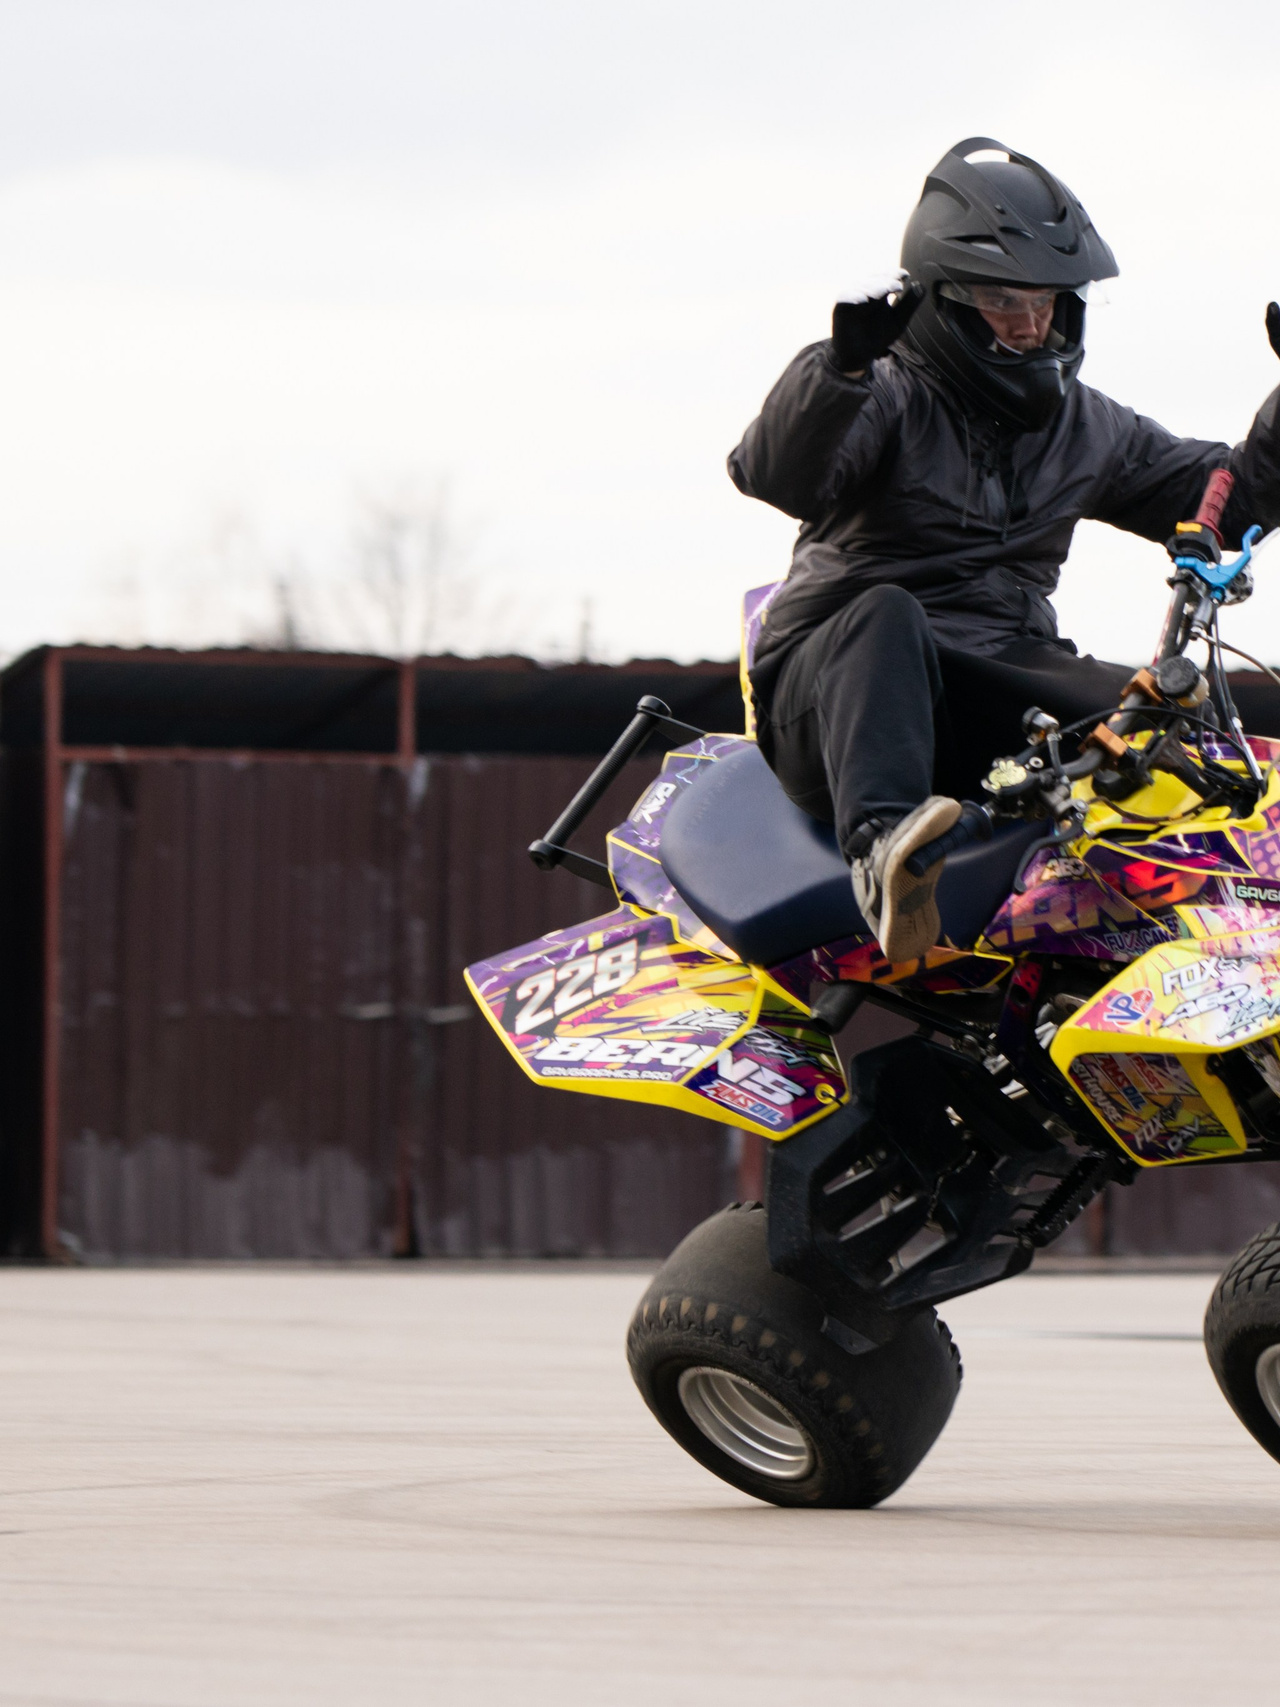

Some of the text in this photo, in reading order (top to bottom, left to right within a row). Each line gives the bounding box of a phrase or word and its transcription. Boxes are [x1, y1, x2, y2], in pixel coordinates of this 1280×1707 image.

[515, 939, 638, 1035] 228
[1161, 956, 1222, 996] FOX
[1104, 994, 1144, 1022] VP
[534, 1036, 806, 1106] BERNS
[1070, 1058, 1124, 1124] STHOUSE
[1099, 1054, 1147, 1112] AMSOIL
[701, 1080, 785, 1125] AMSOIL
[1134, 1115, 1165, 1150] FOX
